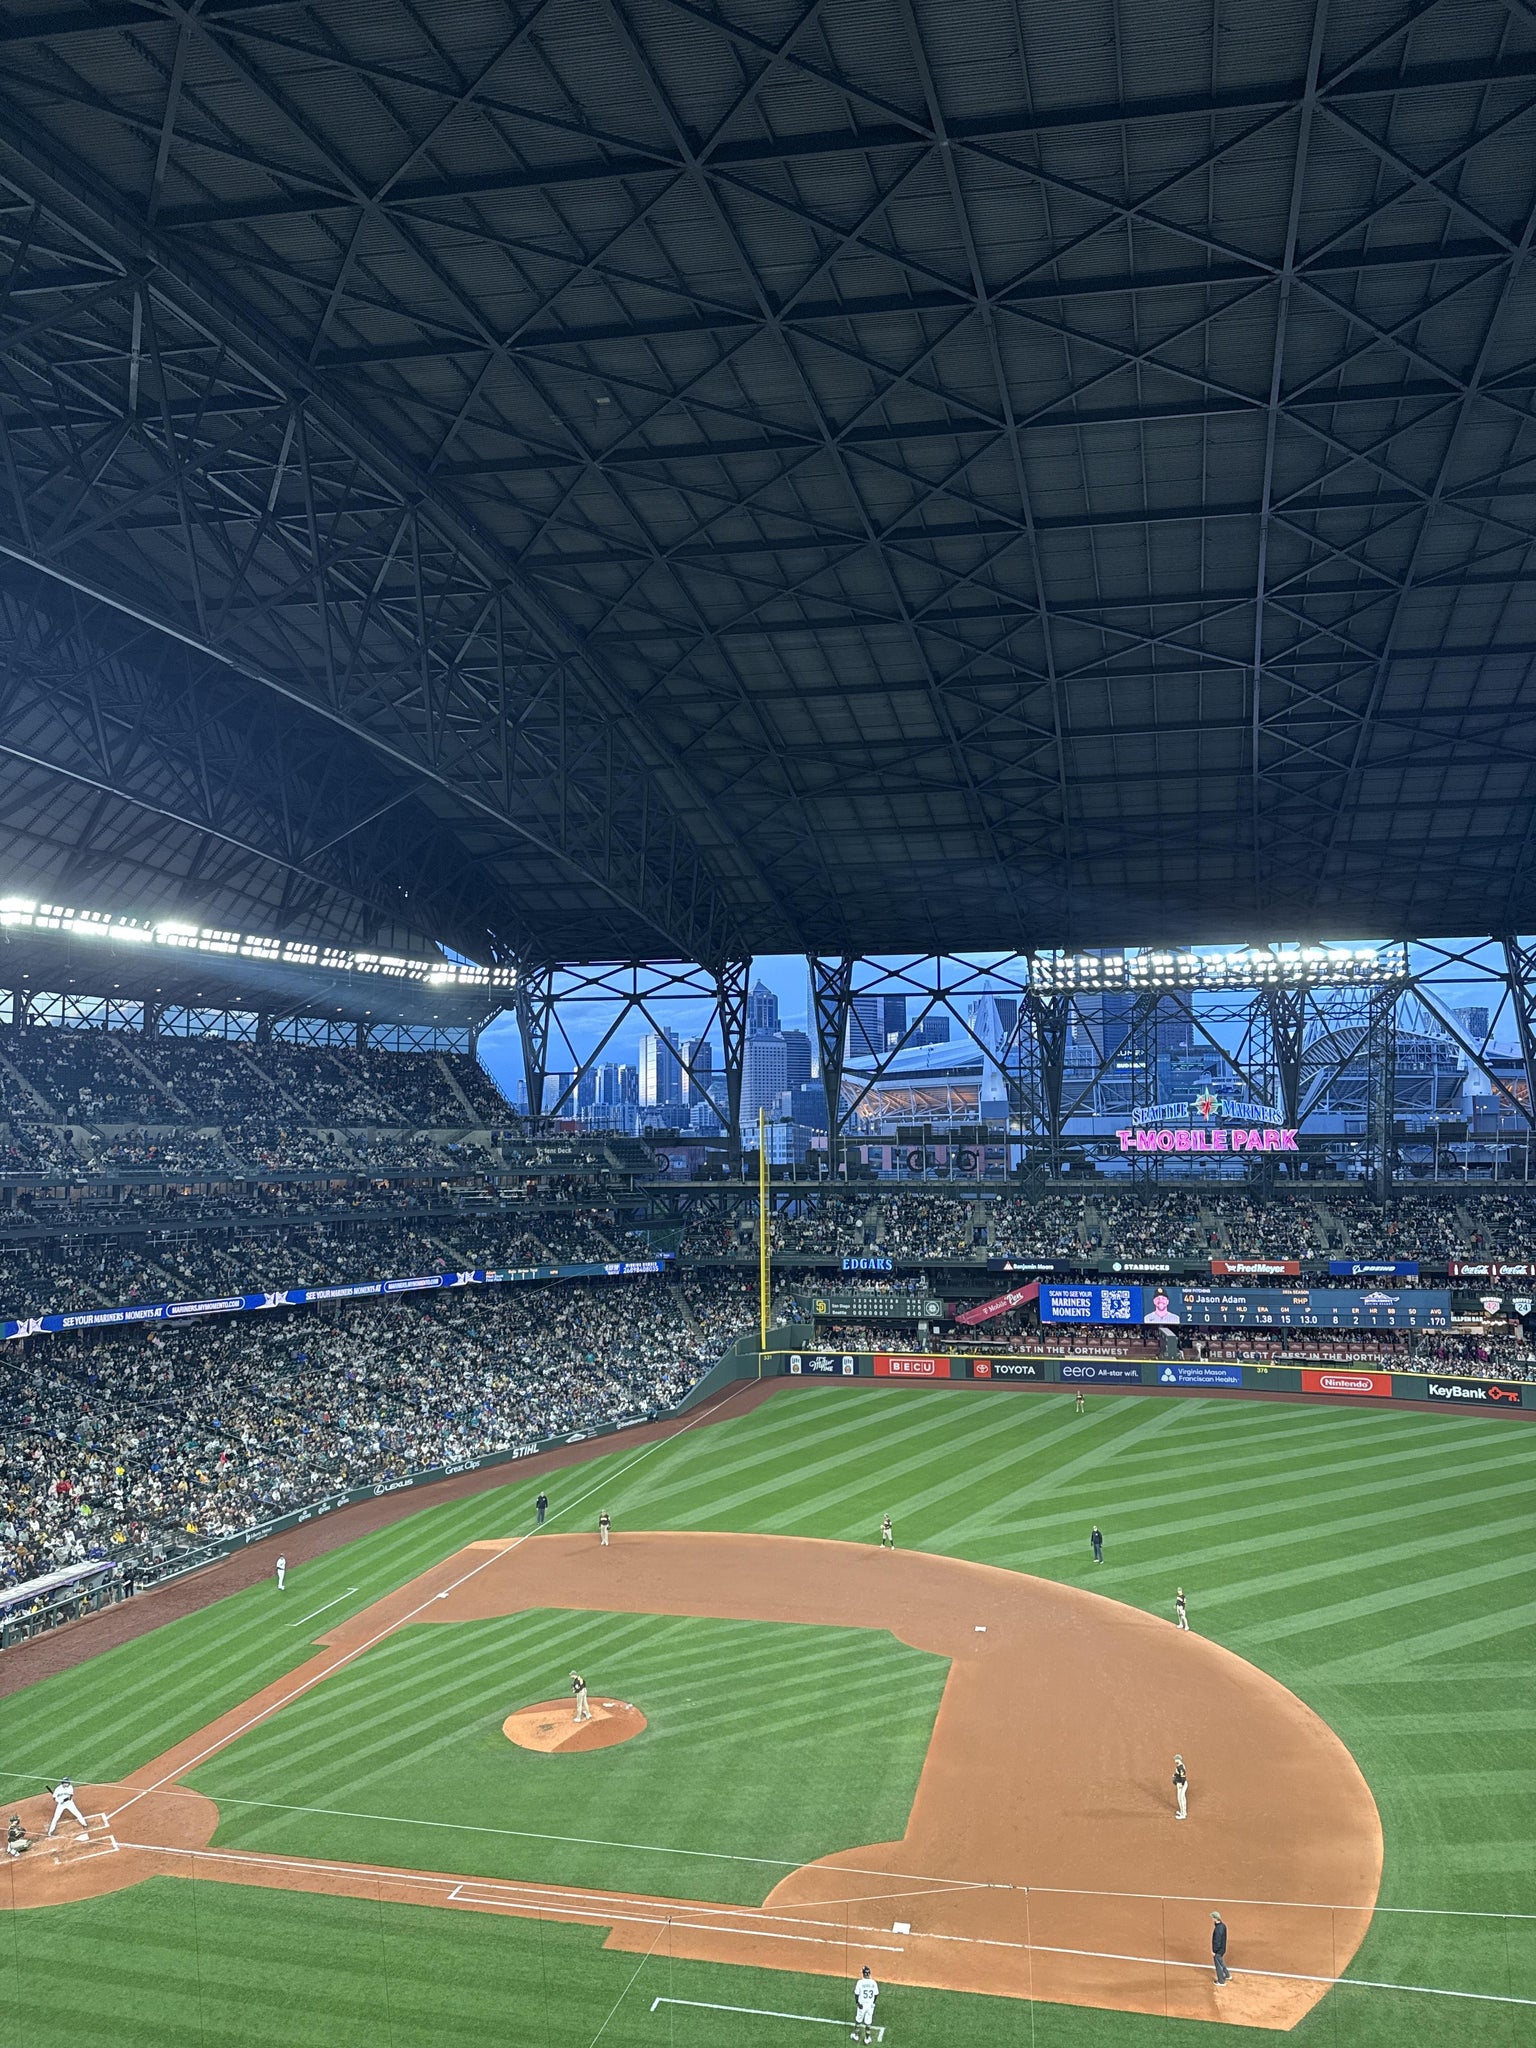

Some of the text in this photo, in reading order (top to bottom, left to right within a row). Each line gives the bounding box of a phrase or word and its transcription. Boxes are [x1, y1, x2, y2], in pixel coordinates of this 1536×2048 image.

[1132, 1099, 1285, 1126] SEATTLE MARINERS
[1115, 1128, 1300, 1151] T-MOBILE PARK
[1123, 1263, 1170, 1272] STARBUCKS
[306, 1291, 316, 1300] SEE
[316, 1290, 330, 1300] YOUR
[1184, 1295, 1246, 1304] 40 Jason Adam
[988, 1300, 1007, 1314] Mobile
[1052, 1298, 1090, 1308] MARINERS
[62, 1308, 162, 1328] SEE YOUR MARINERS MOMENTS AT
[1052, 1308, 1090, 1318] MOMENTS
[1255, 1315, 1272, 1323] 1.38
[1300, 1316, 1317, 1324] 13.0
[1333, 1316, 1338, 1324] 8
[1353, 1317, 1359, 1325] 2
[1389, 1317, 1395, 1325] 3
[1410, 1317, 1416, 1325] 5
[1427, 1318, 1445, 1326] .170
[994, 1365, 1036, 1375] TOYOTA
[1063, 1366, 1096, 1377] eero
[1098, 1368, 1123, 1377] All-star
[1178, 1368, 1201, 1376] Virginia
[1178, 1375, 1214, 1383] Franciscan
[1325, 1378, 1368, 1388] Nintendo
[1429, 1384, 1487, 1399] KeyBank
[512, 1444, 539, 1459] STIHL
[445, 1460, 481, 1476] Great Clips
[384, 1479, 414, 1491] LEXUS
[863, 1990, 874, 1999] 53
